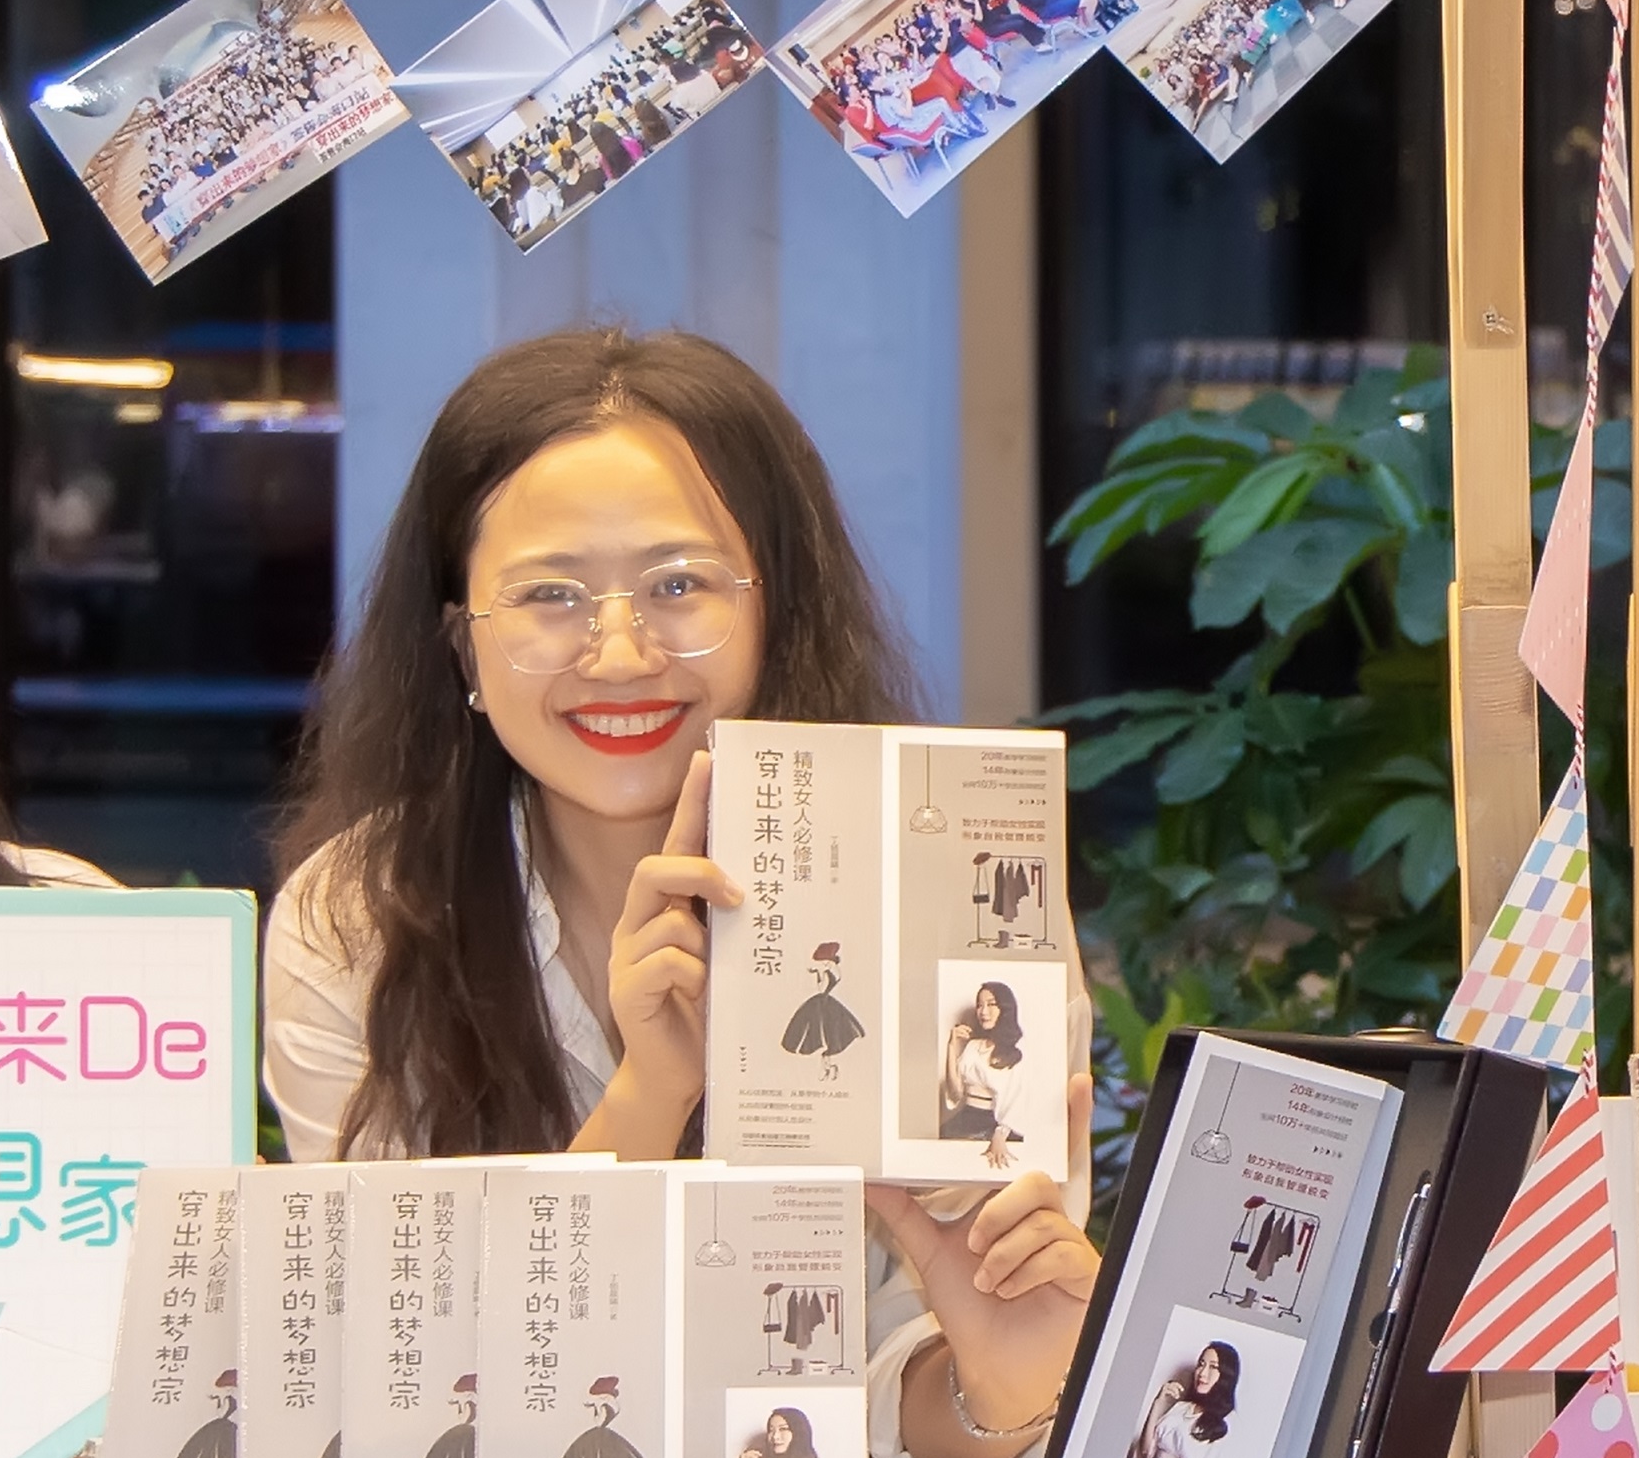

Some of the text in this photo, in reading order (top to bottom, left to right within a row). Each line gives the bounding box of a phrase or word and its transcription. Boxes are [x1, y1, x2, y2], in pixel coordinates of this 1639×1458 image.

[753, 748, 785, 977] 穿出来的梦想家
[792, 749, 814, 884] 精致女人必修课
[152, 1190, 208, 1405] 穿出来的梦想家
[204, 1189, 238, 1314] 精致女人必修课
[282, 1192, 316, 1410] 穿出来的梦想家
[324, 1190, 346, 1316] 精致女人必修课
[388, 1191, 423, 1410] 穿出来的梦想家
[432, 1189, 454, 1319] 精致女人必修课
[523, 1193, 560, 1414] 穿出来的梦想家
[568, 1192, 591, 1321] 精致女人必修课
